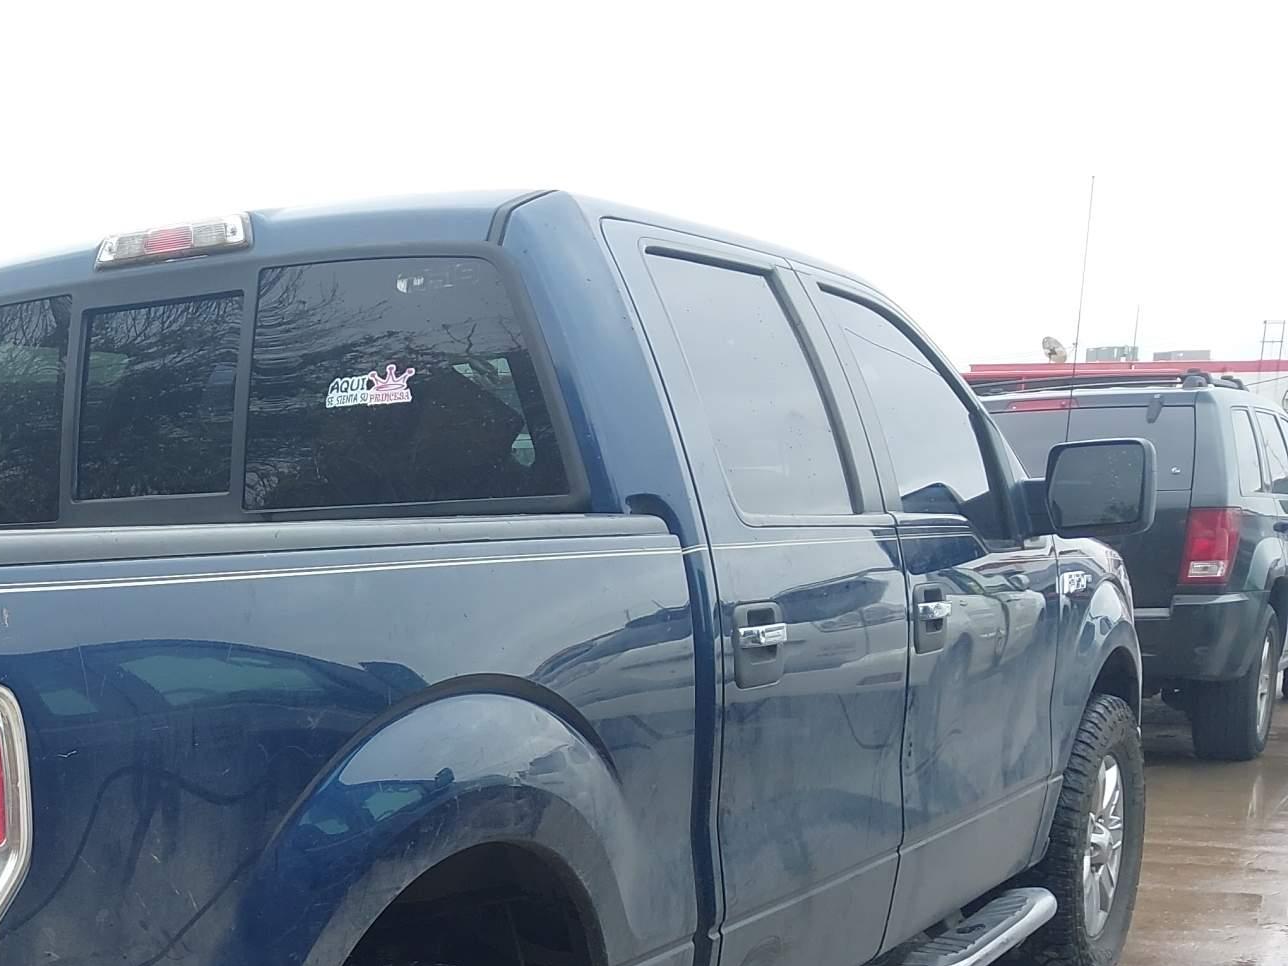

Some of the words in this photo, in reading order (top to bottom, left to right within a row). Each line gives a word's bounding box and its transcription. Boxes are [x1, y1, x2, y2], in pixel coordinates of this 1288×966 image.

[330, 378, 367, 394] AQUI
[336, 393, 358, 405] SIENTA
[360, 392, 369, 402] SU
[369, 391, 410, 403] PRINCESA
